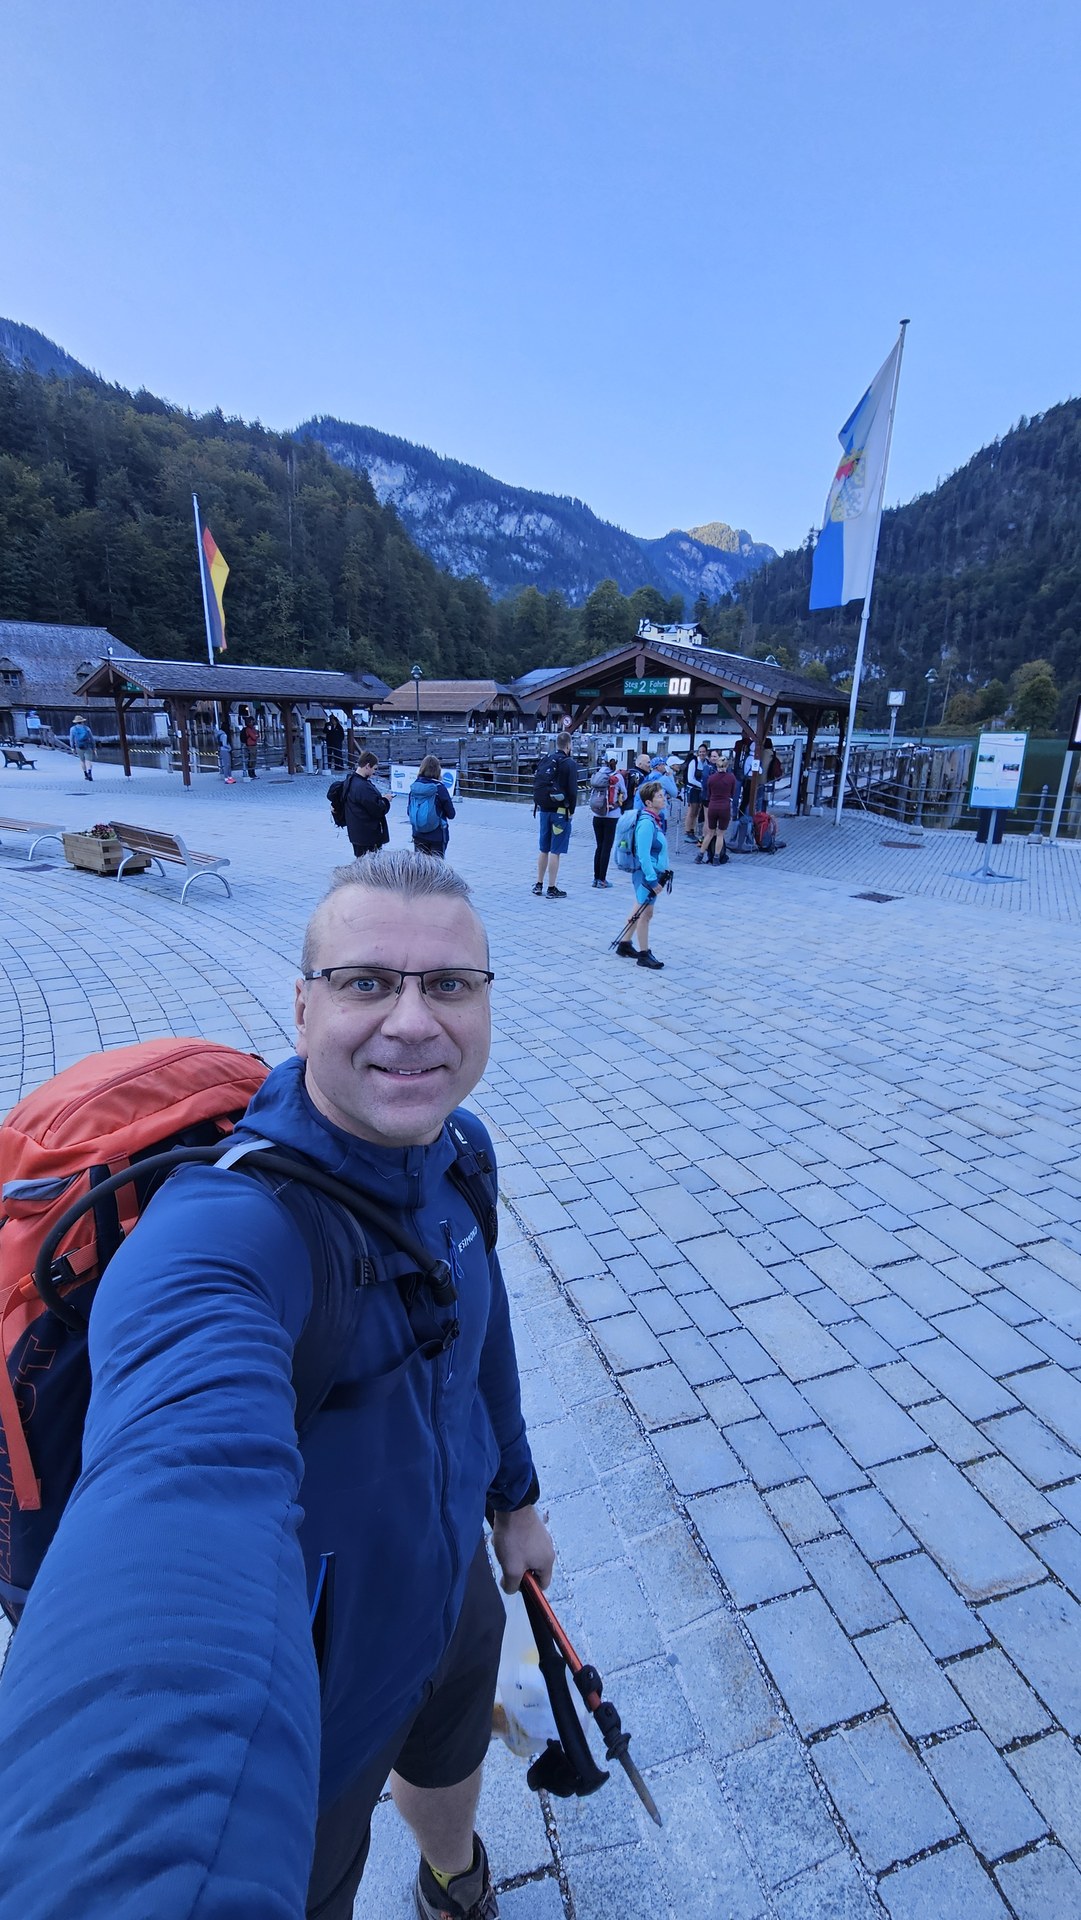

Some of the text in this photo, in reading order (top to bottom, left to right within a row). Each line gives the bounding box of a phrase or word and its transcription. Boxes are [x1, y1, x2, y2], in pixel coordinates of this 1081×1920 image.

[624, 681, 638, 689] Steg
[638, 680, 646, 693] 2
[668, 678, 691, 695] 00
